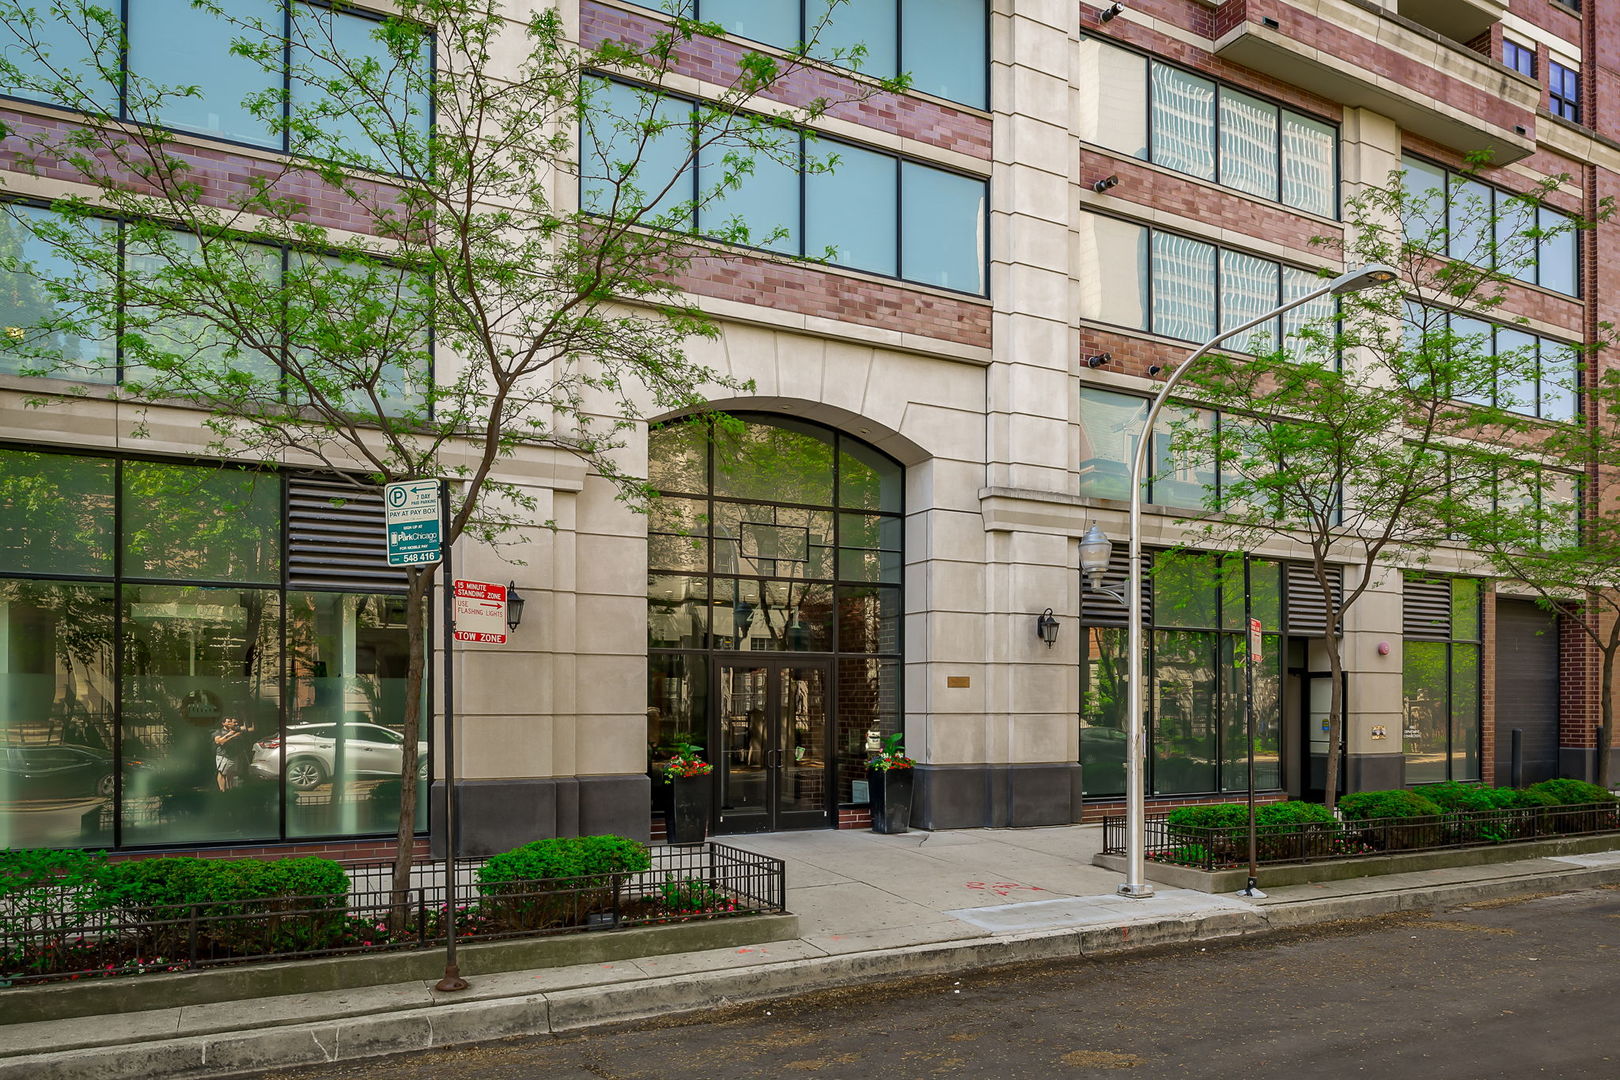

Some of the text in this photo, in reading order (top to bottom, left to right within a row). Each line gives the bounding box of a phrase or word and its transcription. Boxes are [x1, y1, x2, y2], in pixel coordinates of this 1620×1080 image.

[394, 491, 403, 504] P
[398, 532, 437, 542] ParkChicago
[404, 552, 434, 562] 548 416
[467, 583, 487, 591] MINUTE
[458, 589, 485, 598] STANDING
[458, 607, 483, 615] FLASHING
[458, 632, 502, 642] TOW ZONE
